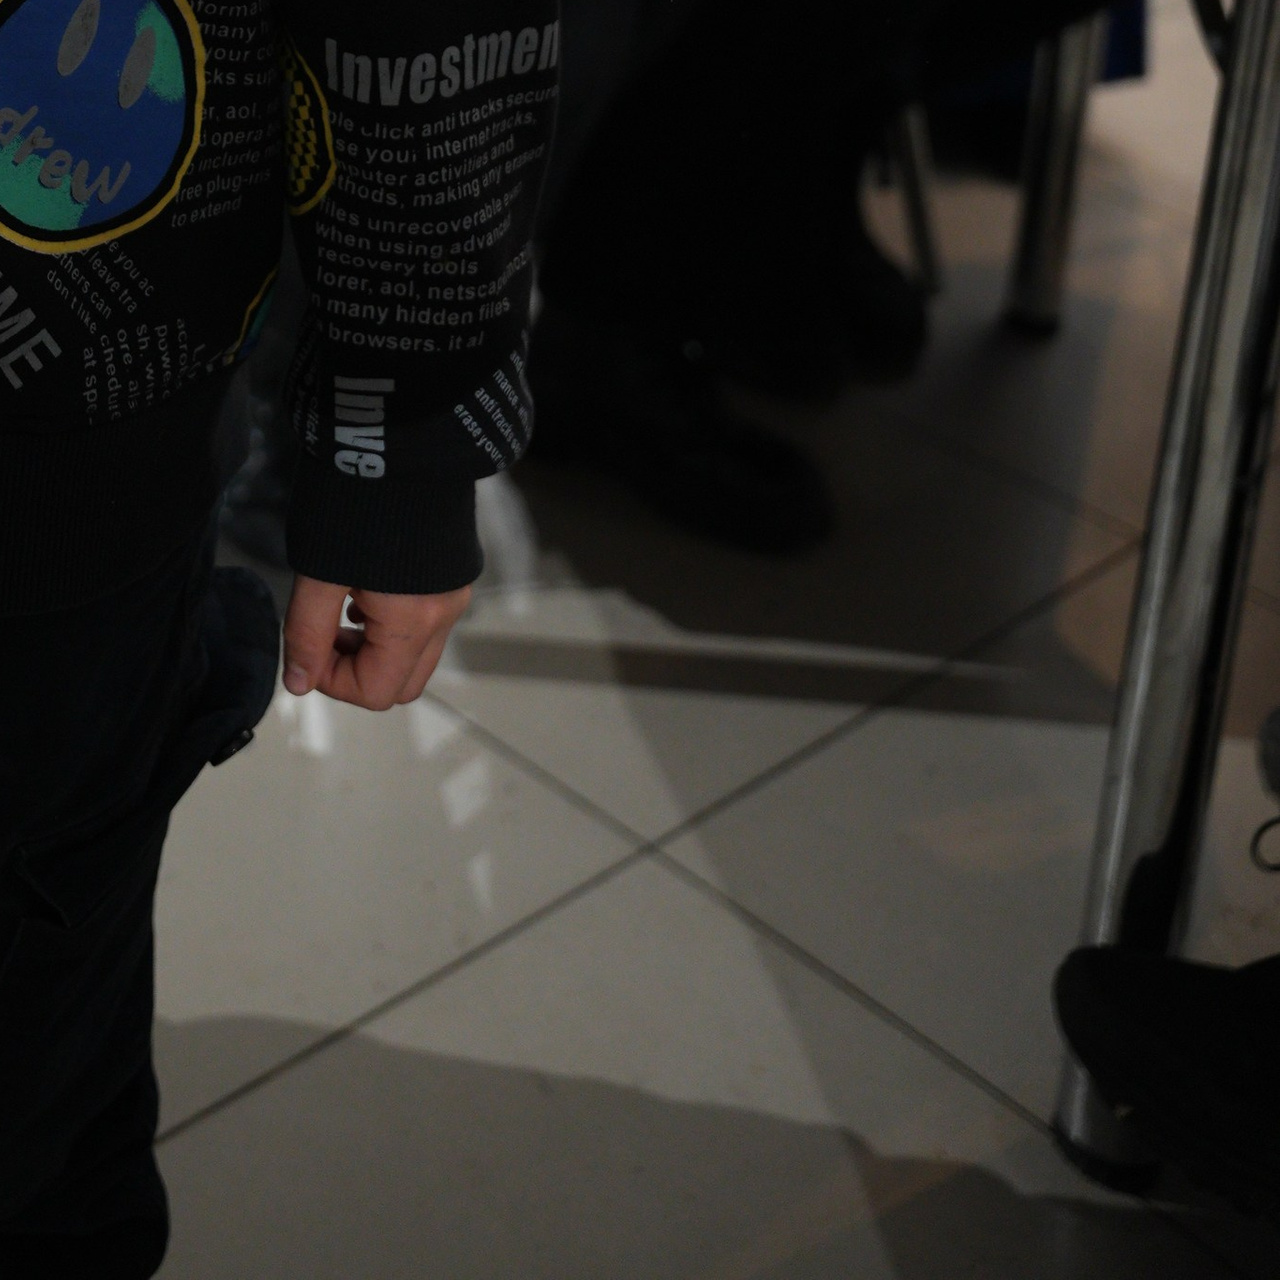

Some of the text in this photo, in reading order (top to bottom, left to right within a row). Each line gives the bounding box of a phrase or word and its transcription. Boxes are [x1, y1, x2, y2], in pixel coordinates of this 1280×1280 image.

[324, 18, 560, 107] Investmen
[421, 96, 504, 137] anti tracks
[414, 134, 515, 186] activities and
[426, 126, 492, 161] internet
[190, 195, 243, 224] extend
[413, 177, 481, 208] making
[368, 197, 503, 236] unrecoverable
[315, 220, 444, 259] when using
[317, 245, 479, 276] recovery tools
[327, 295, 511, 327] many hidden files
[453, 402, 480, 439] erase
